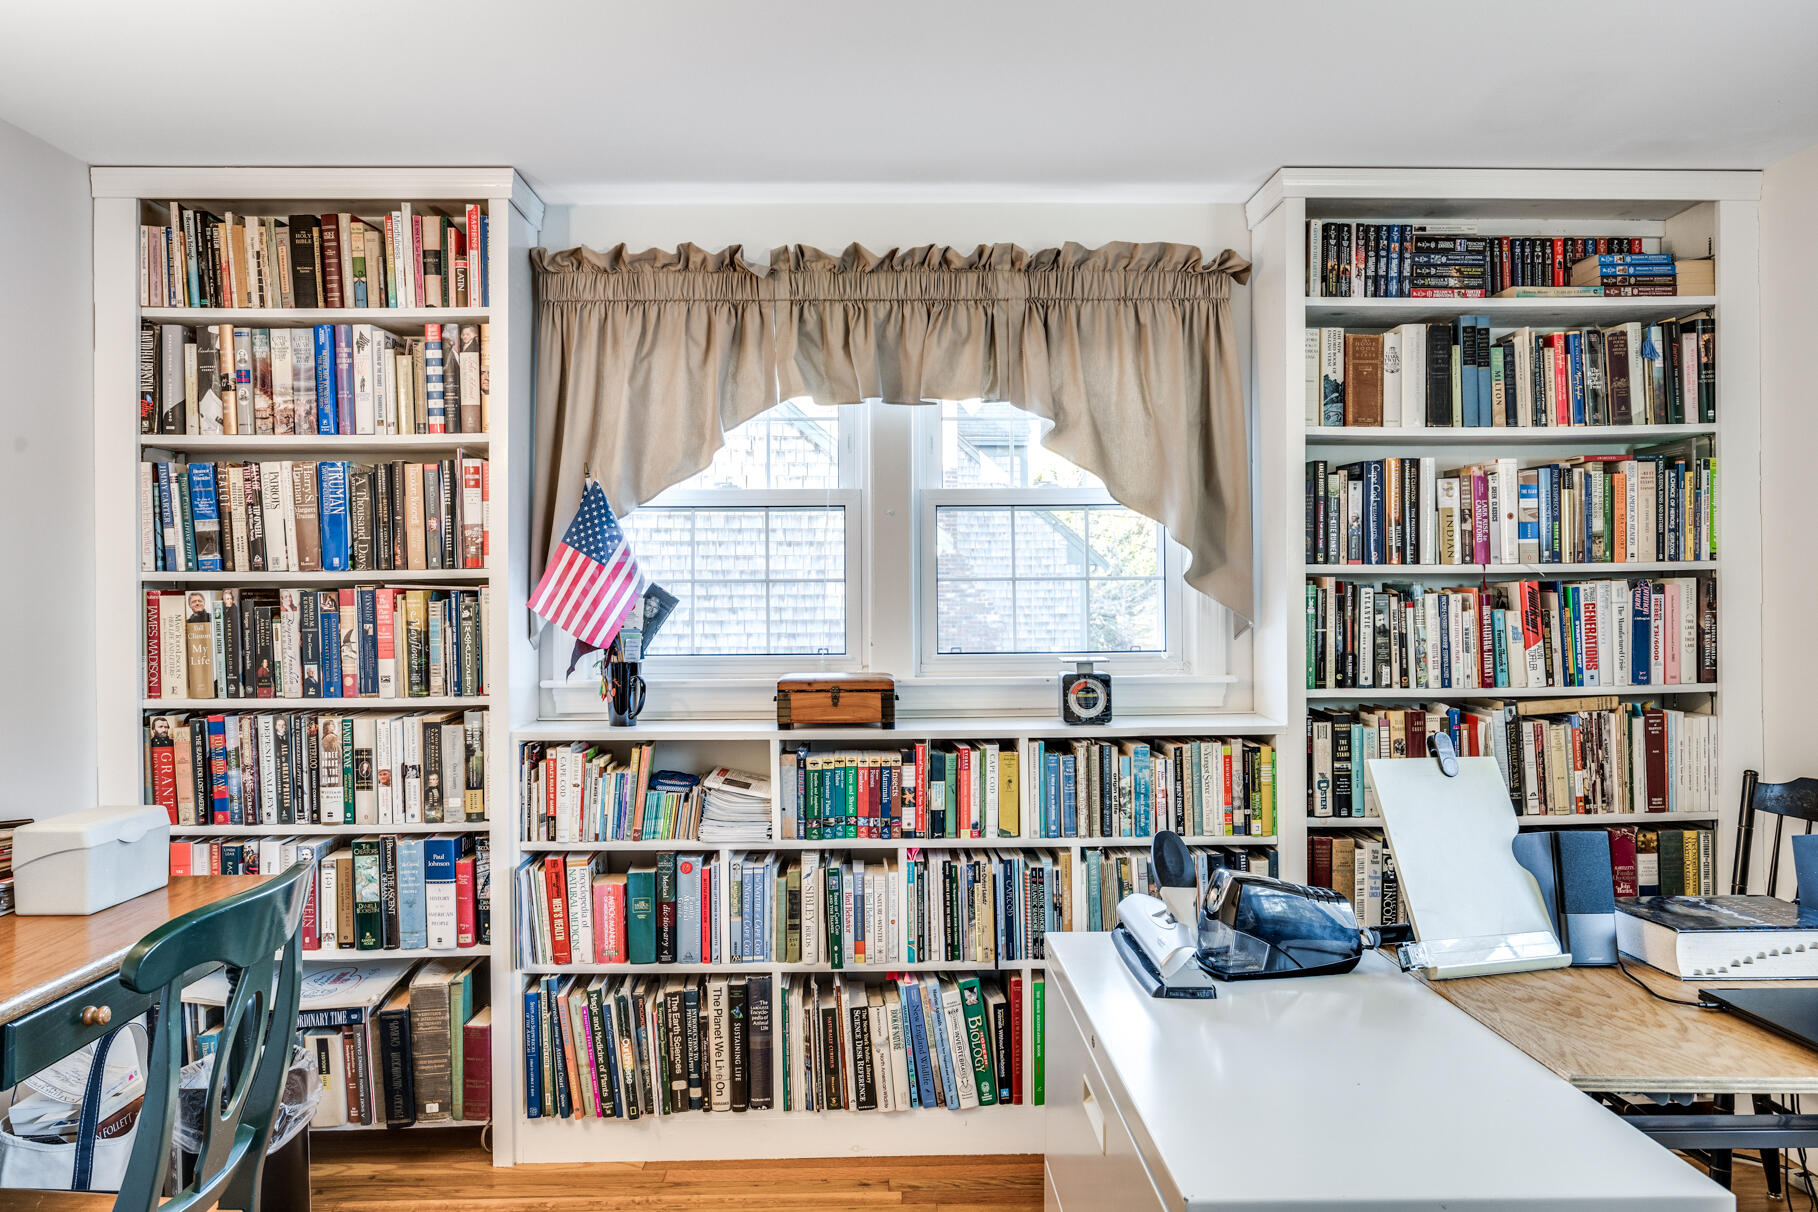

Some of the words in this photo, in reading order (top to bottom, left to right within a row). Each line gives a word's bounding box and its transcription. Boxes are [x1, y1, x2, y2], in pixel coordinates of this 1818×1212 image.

[141, 330, 153, 350] DAVID
[141, 351, 154, 392] HALBERSTAM
[1494, 370, 1502, 406] MILTON
[158, 465, 170, 489] JIMMY
[243, 466, 251, 478] THE
[293, 465, 303, 504] Truman
[303, 465, 313, 493] Harry
[355, 476, 366, 485] A
[218, 467, 229, 507] ZEALOT
[244, 479, 253, 504] HOUSE
[305, 495, 314, 503] S.
[328, 466, 345, 514] TRUMAN
[161, 493, 170, 523] CARTER
[253, 505, 261, 515] TIP
[356, 489, 370, 540] Thousand
[254, 516, 262, 539] O'NEILL
[1475, 500, 1483, 543] CANDLEFORD
[1446, 514, 1455, 558] INDIAN
[357, 544, 369, 569] Days
[147, 606, 158, 636] JAMES
[192, 644, 208, 654] My
[409, 620, 421, 670] Mayflower
[1583, 602, 1598, 671] GENERATIONS
[148, 640, 159, 687] MADISON
[191, 655, 210, 666] Life
[214, 736, 224, 753] TOM
[343, 722, 352, 746] DANIEL
[343, 747, 352, 768] BOONE
[161, 752, 174, 807] GRANT
[215, 756, 225, 792] BROKAW
[891, 769, 900, 797] Insects
[1114, 795, 1118, 803] of
[1702, 835, 1710, 858] DICTIONARY
[568, 869, 577, 909] NATURAL
[579, 868, 588, 918] Encyclopedia
[744, 884, 752, 912] NATURE
[754, 884, 762, 912] NATURE
[553, 898, 563, 918] MEN'S
[805, 886, 814, 924] SIBLEY
[554, 919, 564, 940] HEALTH
[571, 912, 580, 952] MEDICINE
[582, 920, 589, 928] of
[744, 920, 752, 938] CAPE
[755, 939, 763, 955] COD
[589, 993, 598, 1015] Magic
[672, 995, 680, 1012] The
[713, 987, 722, 1007] The
[296, 1012, 329, 1028] ORDINARY
[330, 1010, 347, 1024] TIME
[672, 1013, 681, 1035] Earth
[713, 1009, 723, 1040] Planet
[853, 1009, 861, 1039] SCIENCE
[912, 1005, 920, 1023] New
[595, 1032, 604, 1063] Medicine
[715, 1042, 723, 1058] We
[734, 1023, 742, 1064] SUSTAINING
[855, 1040, 863, 1059] DESK
[915, 1024, 925, 1056] England
[968, 1016, 985, 1073] BIOLOGY
[673, 1036, 682, 1074] Sciences
[694, 1053, 698, 1061] TO
[599, 1065, 606, 1073] of
[715, 1060, 724, 1080] Live
[857, 1061, 866, 1102] REFERENCE
[920, 1058, 929, 1086] Wildlife
[600, 1075, 609, 1097] Plants
[716, 1082, 725, 1096] On
[104, 1112, 132, 1137] FOLLETT
